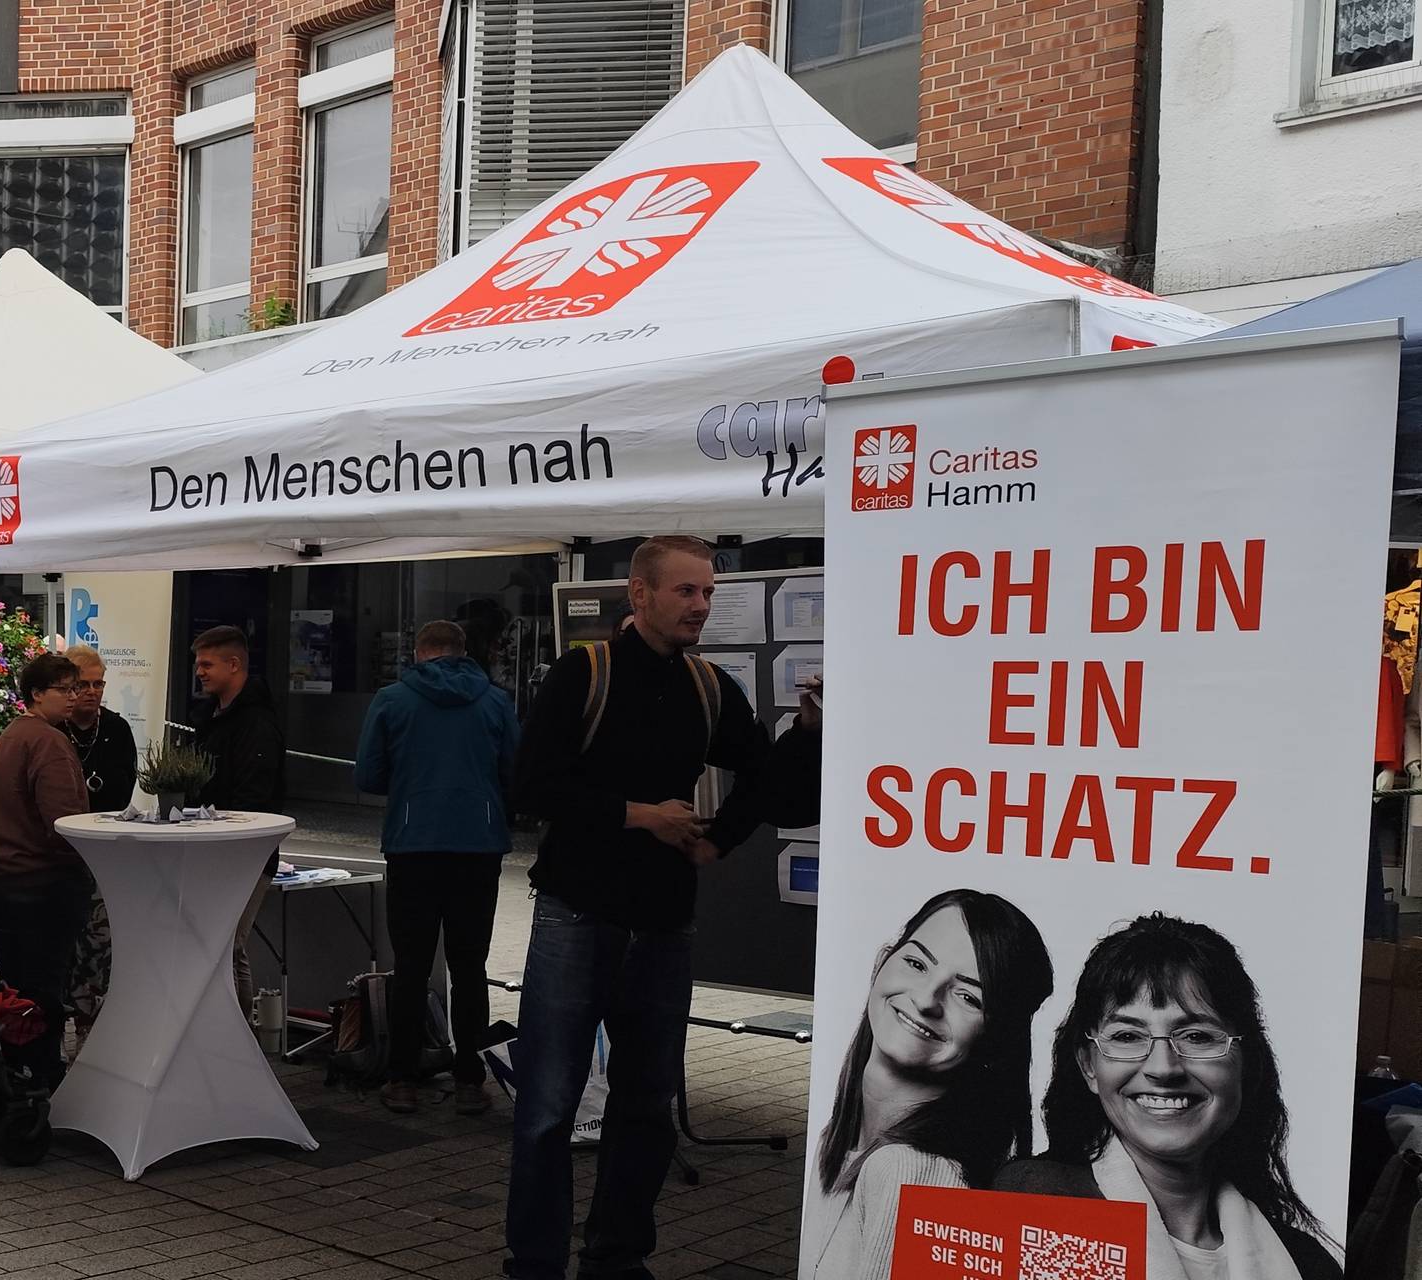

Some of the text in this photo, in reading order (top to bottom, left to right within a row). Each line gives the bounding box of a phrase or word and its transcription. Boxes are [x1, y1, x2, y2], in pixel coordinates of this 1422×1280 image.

[421, 292, 606, 334] caritas
[302, 323, 660, 376] Den Menschen nah
[150, 423, 613, 513] Den Menschen nah
[928, 446, 1039, 475] Caritas
[855, 493, 909, 510] caritas
[927, 480, 1037, 508] Hamm
[897, 548, 1051, 637] ICH
[1090, 539, 1266, 634] BIN
[100, 648, 136, 656] EVANGELISCHE
[988, 660, 1144, 749] EIN
[864, 764, 1271, 874] SCHATZ.
[913, 1218, 1004, 1253] BEWERBEN
[931, 1245, 1003, 1277] SIE SICH
